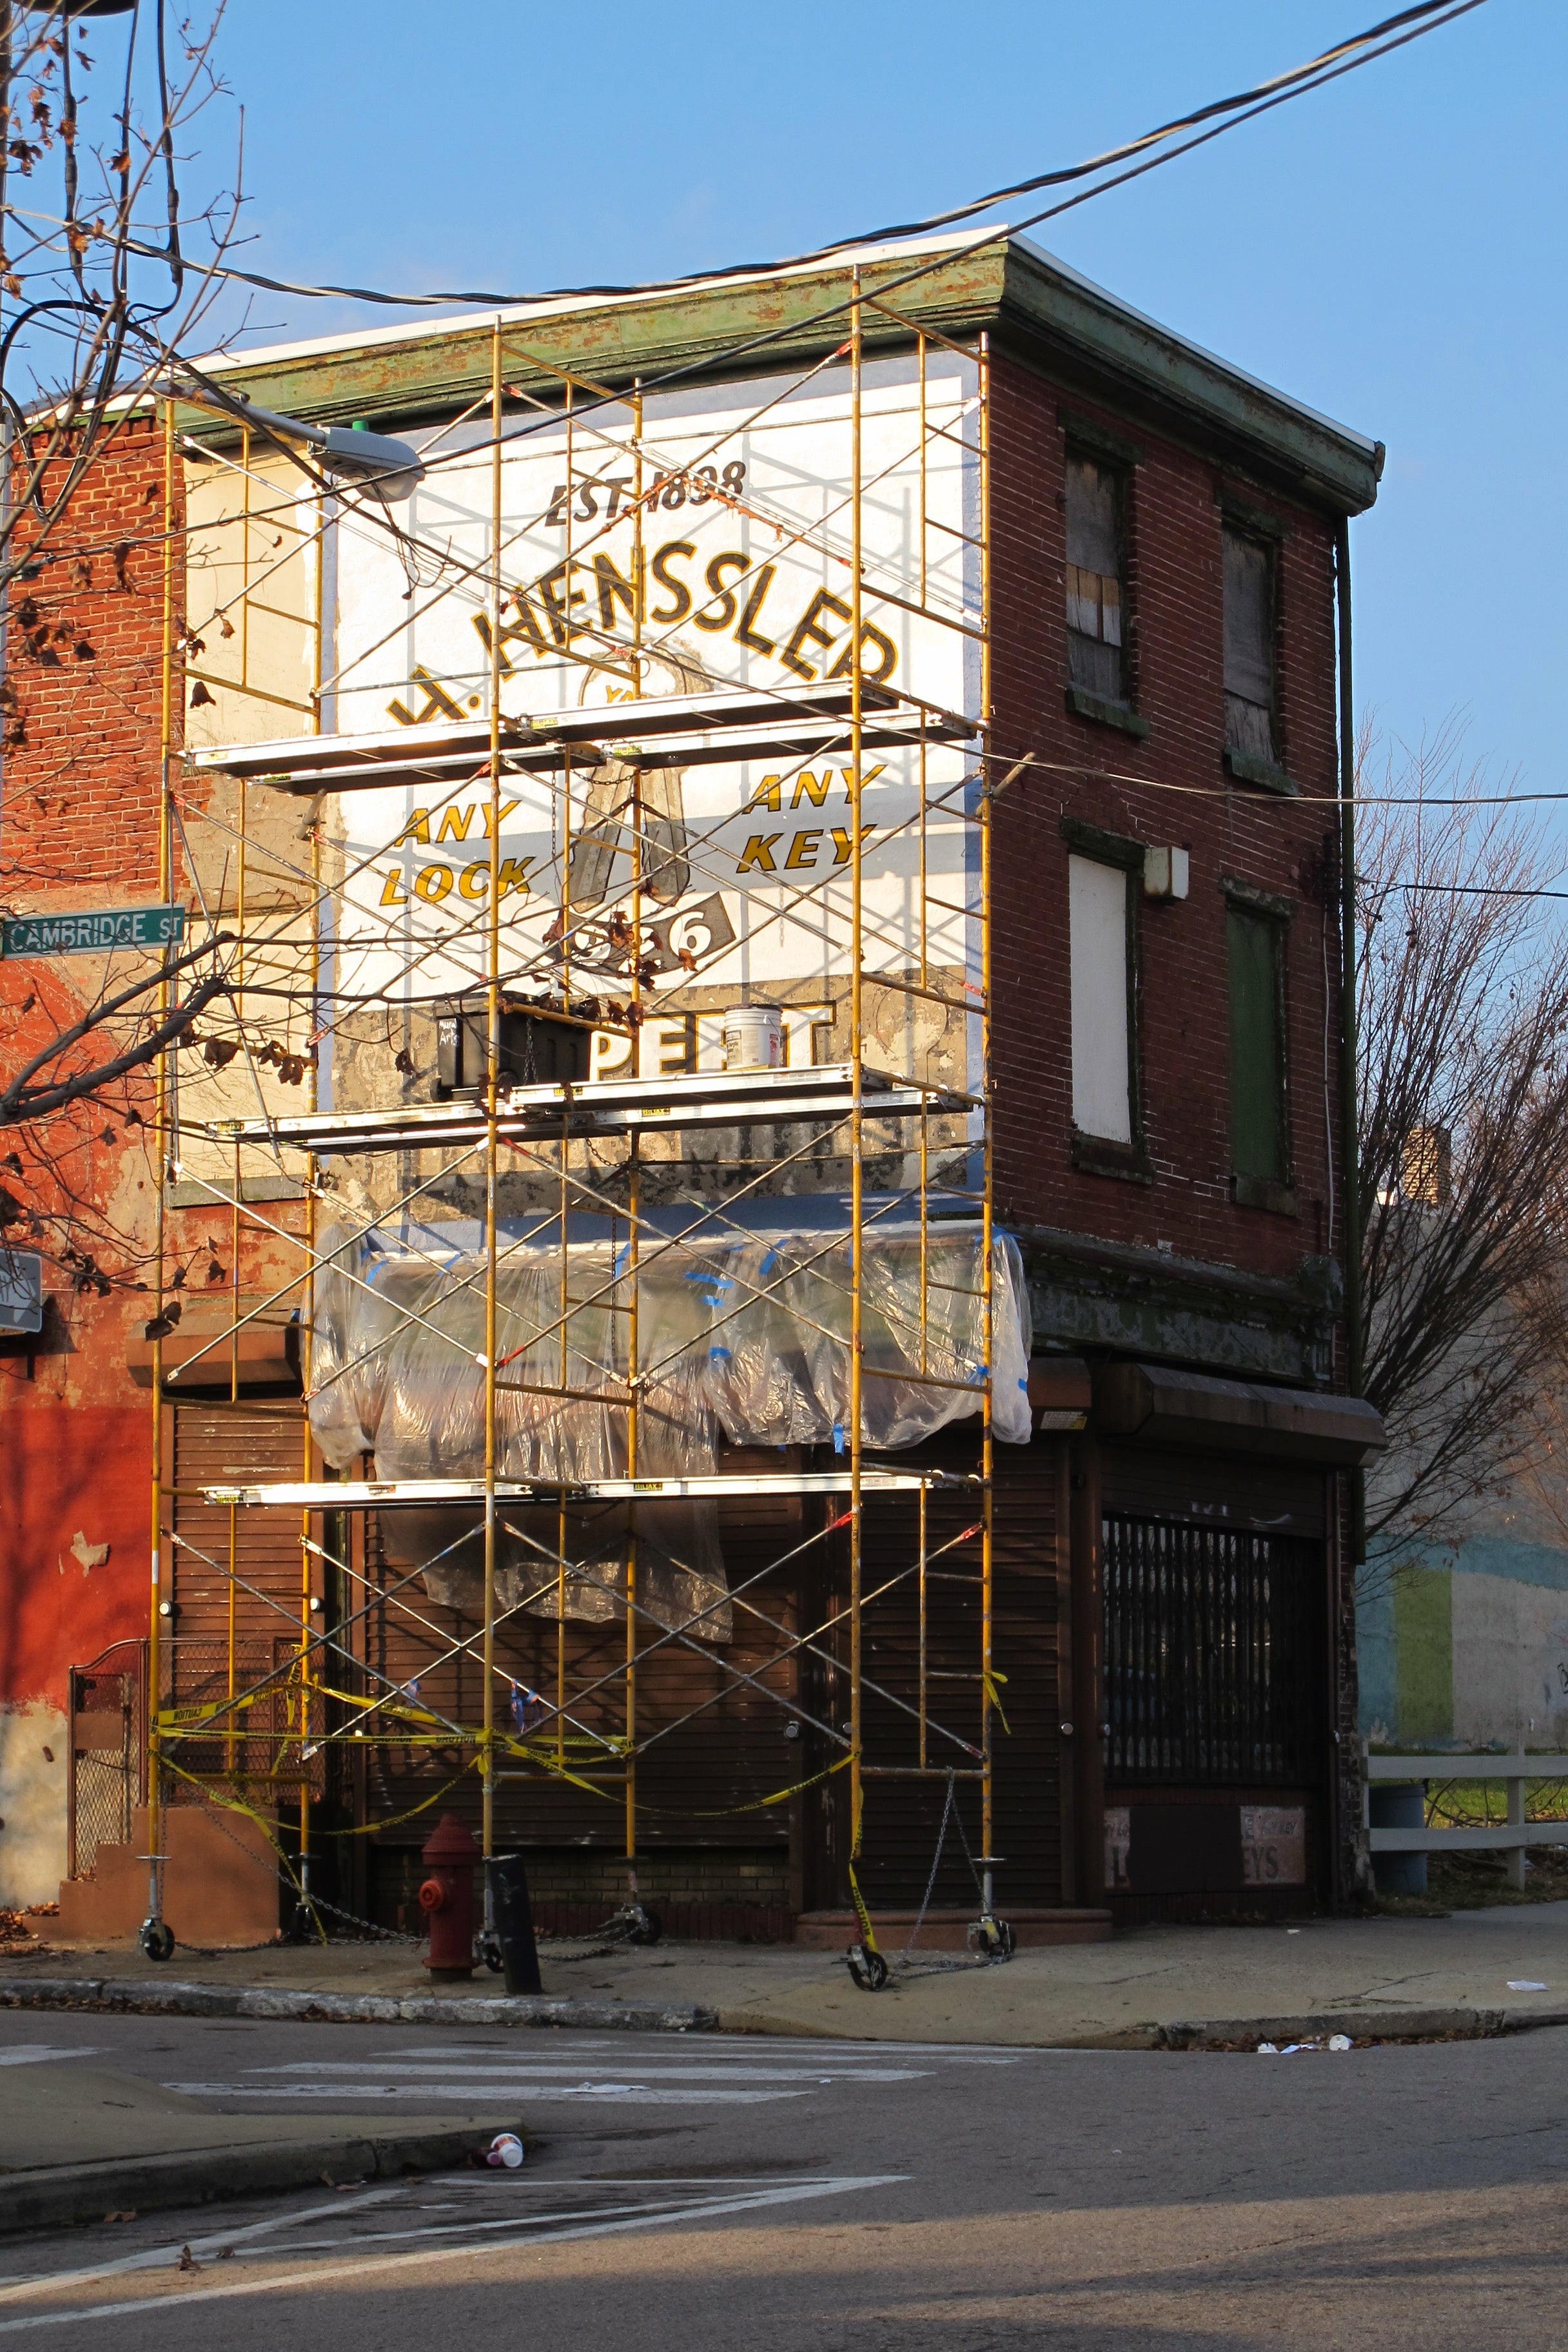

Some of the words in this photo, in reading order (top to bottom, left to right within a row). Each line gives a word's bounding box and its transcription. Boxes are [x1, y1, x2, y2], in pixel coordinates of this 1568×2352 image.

[647, 460, 746, 513] 1898
[471, 540, 898, 684] HENSSLER
[742, 764, 888, 814] ANY
[393, 799, 522, 847] ANY
[736, 823, 878, 874] KEY
[379, 856, 536, 906] LOCK
[10, 914, 146, 952] CAMBRIDGE
[159, 916, 181, 939] ST
[1243, 1845, 1279, 1879] EYS
